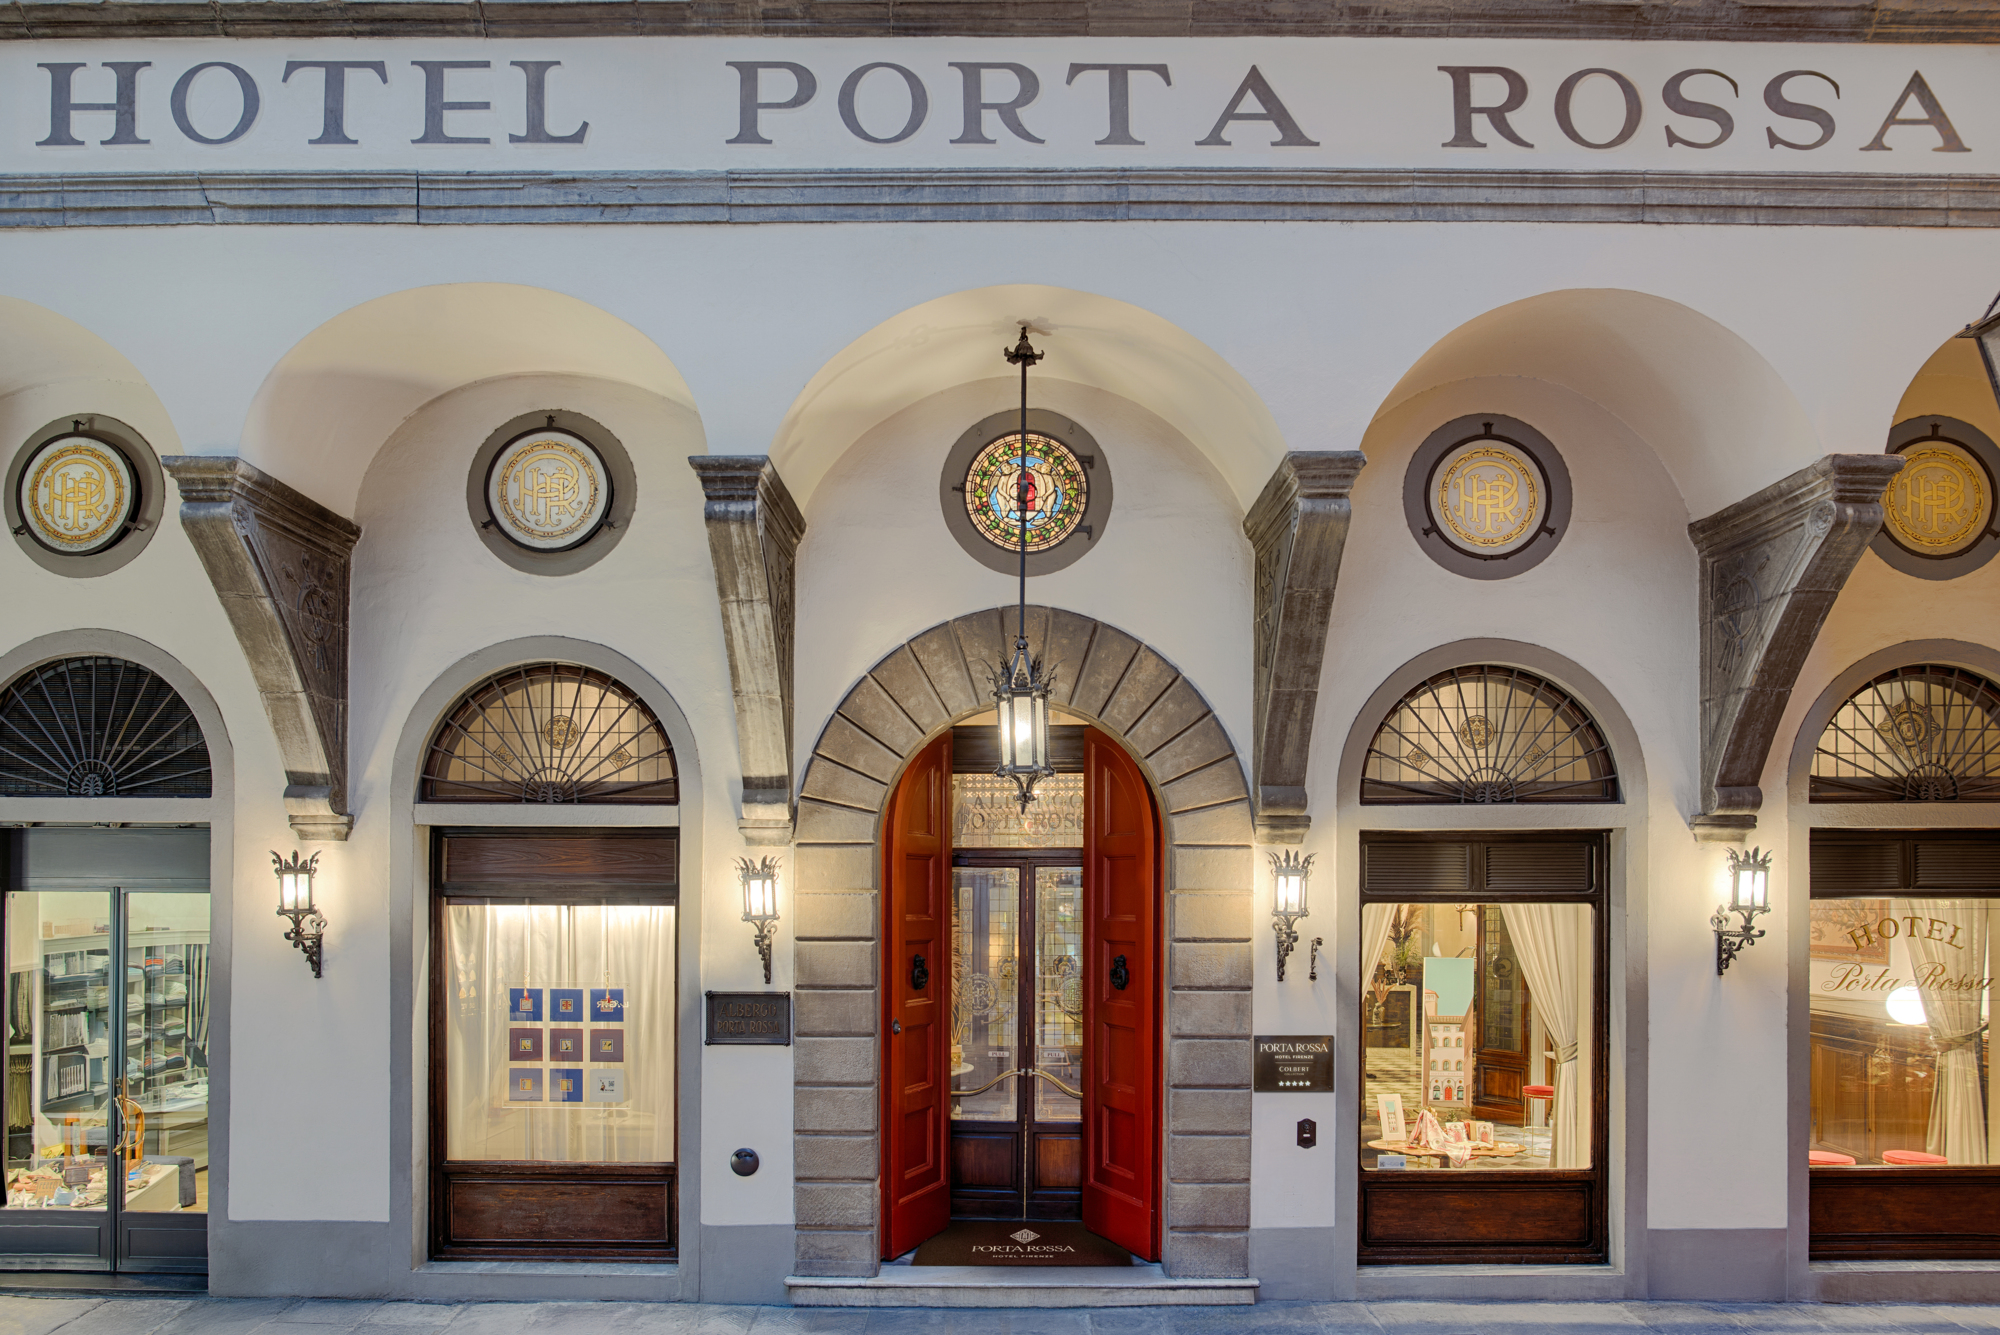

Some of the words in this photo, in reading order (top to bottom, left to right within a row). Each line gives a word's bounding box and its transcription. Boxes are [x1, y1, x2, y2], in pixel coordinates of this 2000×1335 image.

[34, 60, 590, 147] HOTEL
[725, 60, 1322, 147] PORTA
[1437, 65, 1974, 154] ROSSA
[1846, 916, 1965, 951] HOTEL
[1821, 961, 1900, 991] Porta
[1904, 961, 1995, 991] Rossa
[719, 1003, 777, 1017] ALBERGO
[717, 1020, 746, 1033] PORTA
[750, 1020, 780, 1033] ROSSA
[1260, 1043, 1294, 1053] PORTA
[1296, 1043, 1328, 1053] ROSSA
